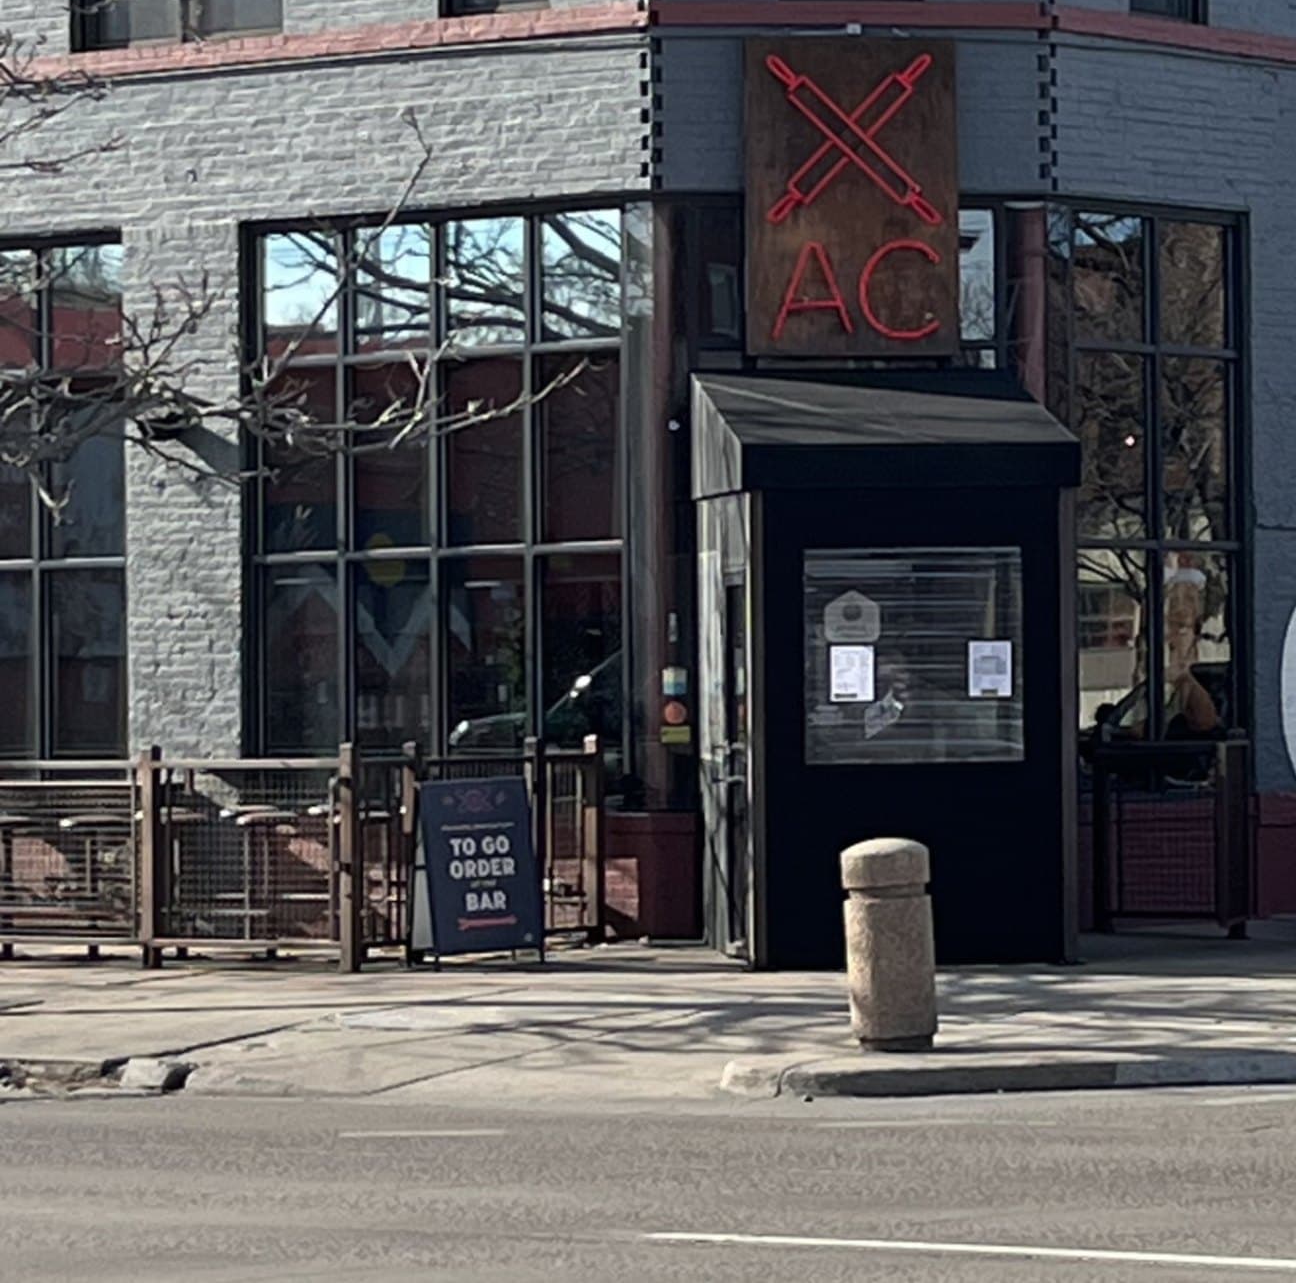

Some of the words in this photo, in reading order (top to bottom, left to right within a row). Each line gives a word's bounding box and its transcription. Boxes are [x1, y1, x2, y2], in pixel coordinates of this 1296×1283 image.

[772, 240, 941, 341] AC
[450, 837, 476, 856] TO
[481, 835, 510, 854] GO
[450, 857, 515, 879] ORDER
[465, 891, 506, 912] BAR
